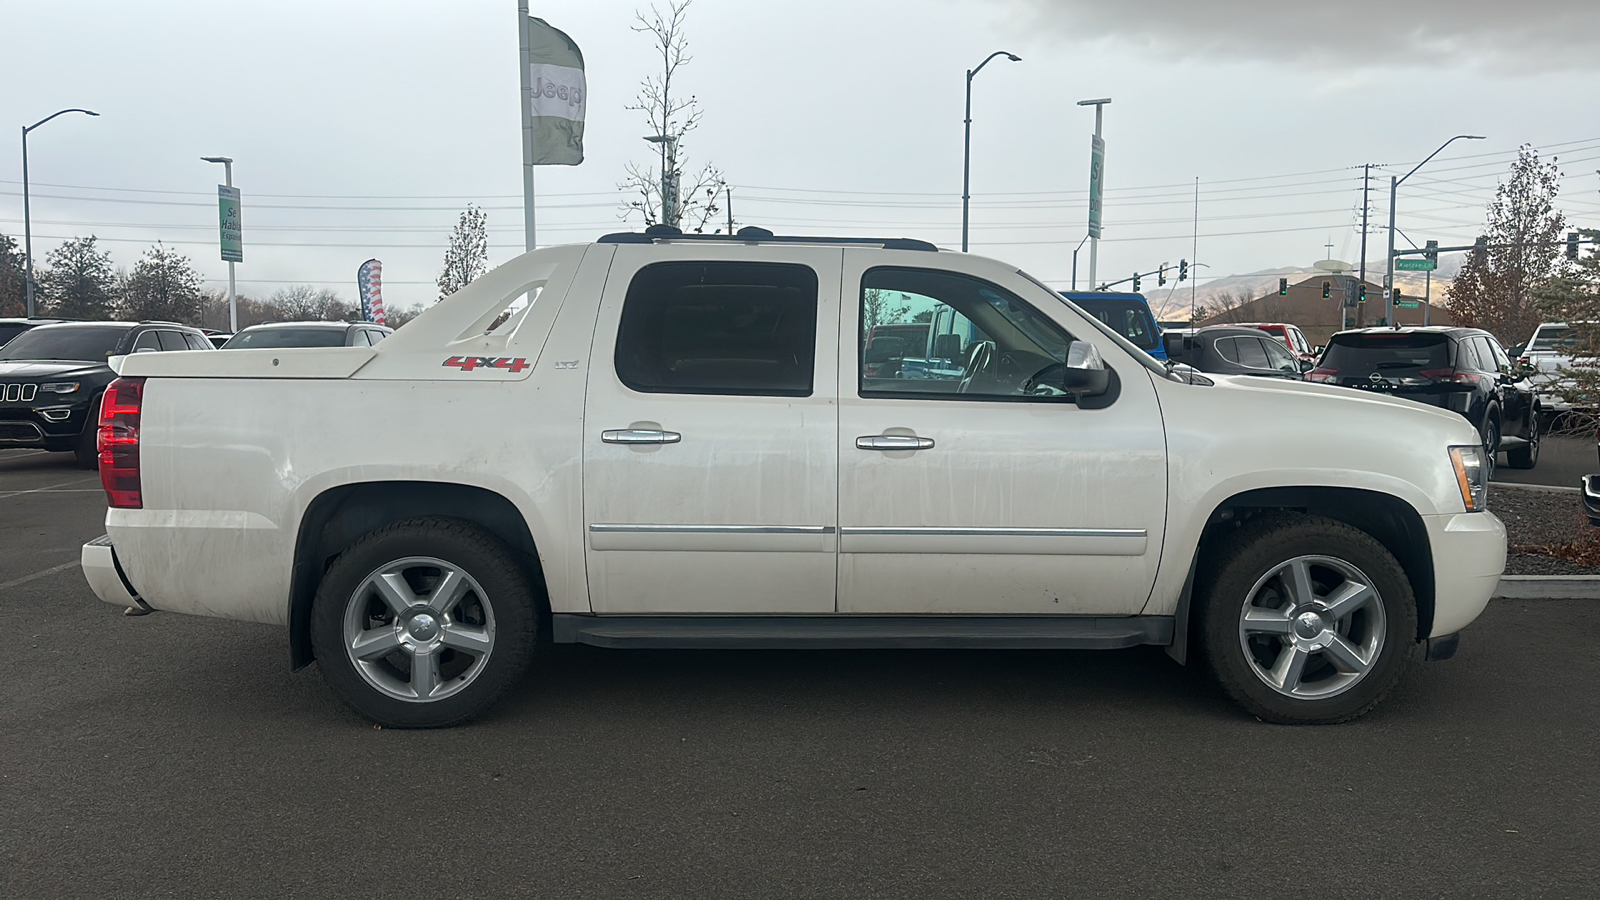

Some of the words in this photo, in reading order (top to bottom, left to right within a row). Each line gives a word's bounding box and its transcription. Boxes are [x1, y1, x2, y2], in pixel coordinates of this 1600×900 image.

[531, 77, 582, 107] Jeep
[227, 207, 237, 218] Se
[222, 231, 241, 241] Espa
